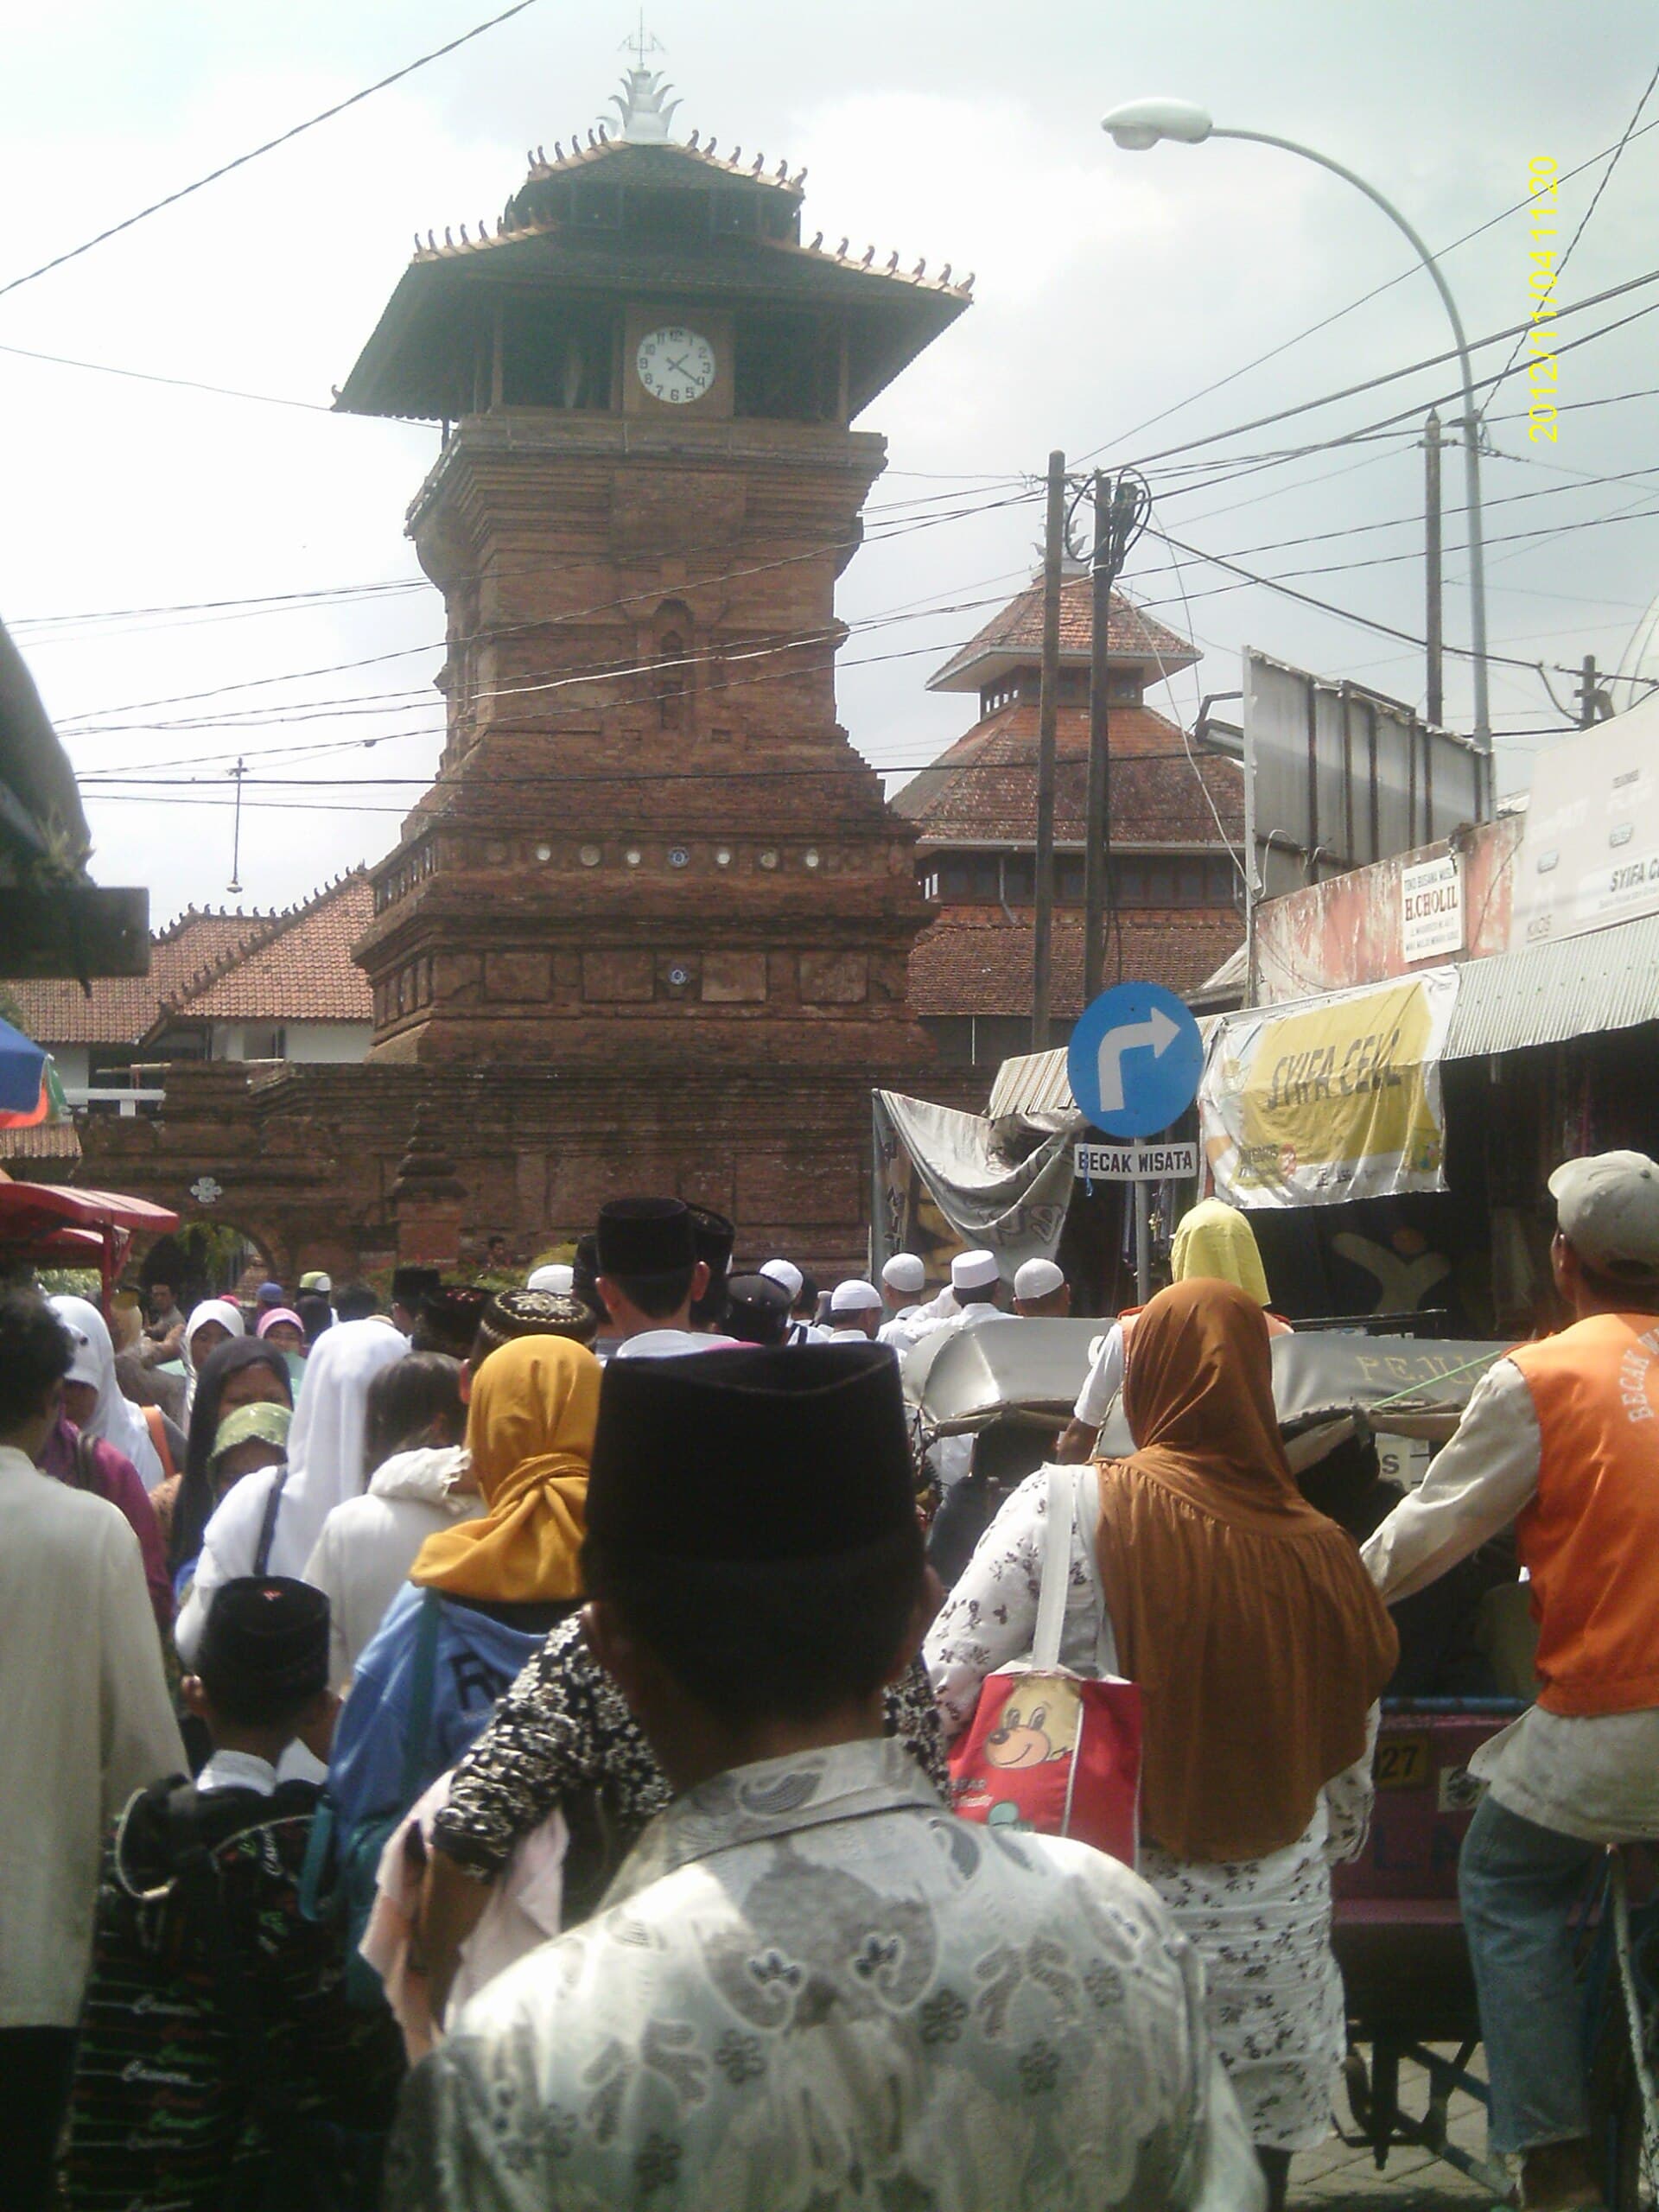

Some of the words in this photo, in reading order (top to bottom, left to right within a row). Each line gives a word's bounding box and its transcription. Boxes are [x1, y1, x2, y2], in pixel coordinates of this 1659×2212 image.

[1405, 885, 1459, 921] H.CHOLIL
[1078, 1151, 1132, 1173] BECAK
[1139, 1150, 1192, 1173] WISATA
[1619, 1349, 1654, 1422] BECAK
